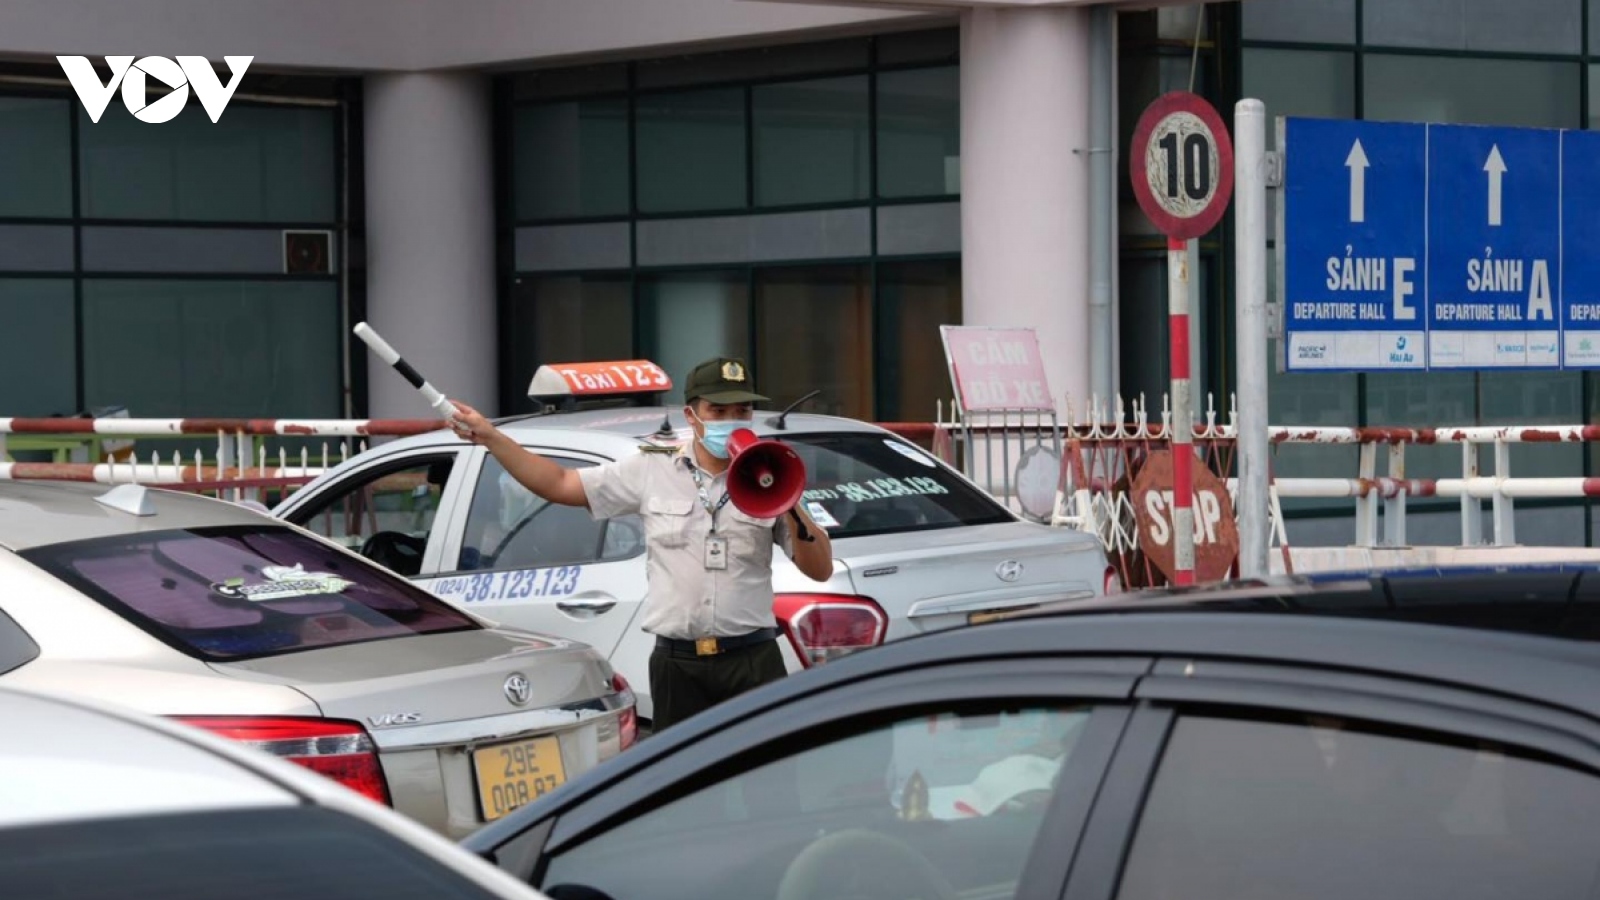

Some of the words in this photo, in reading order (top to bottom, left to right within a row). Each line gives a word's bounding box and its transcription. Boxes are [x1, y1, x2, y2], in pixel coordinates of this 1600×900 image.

[1159, 131, 1210, 200] 10
[1326, 244, 1385, 291] SẢNH
[1393, 257, 1416, 320] E
[1466, 246, 1523, 292] SẢNH
[1527, 259, 1553, 321] A
[1294, 302, 1356, 320] DEPARTURE
[1359, 303, 1385, 320] HALL
[1435, 303, 1495, 321] DEPARTURE
[1497, 304, 1522, 321] HALL
[561, 368, 617, 391] Taxi
[610, 363, 668, 388] 123
[1013, 380, 1044, 405] XE
[366, 711, 422, 728] VIOS
[500, 742, 540, 779] 29E
